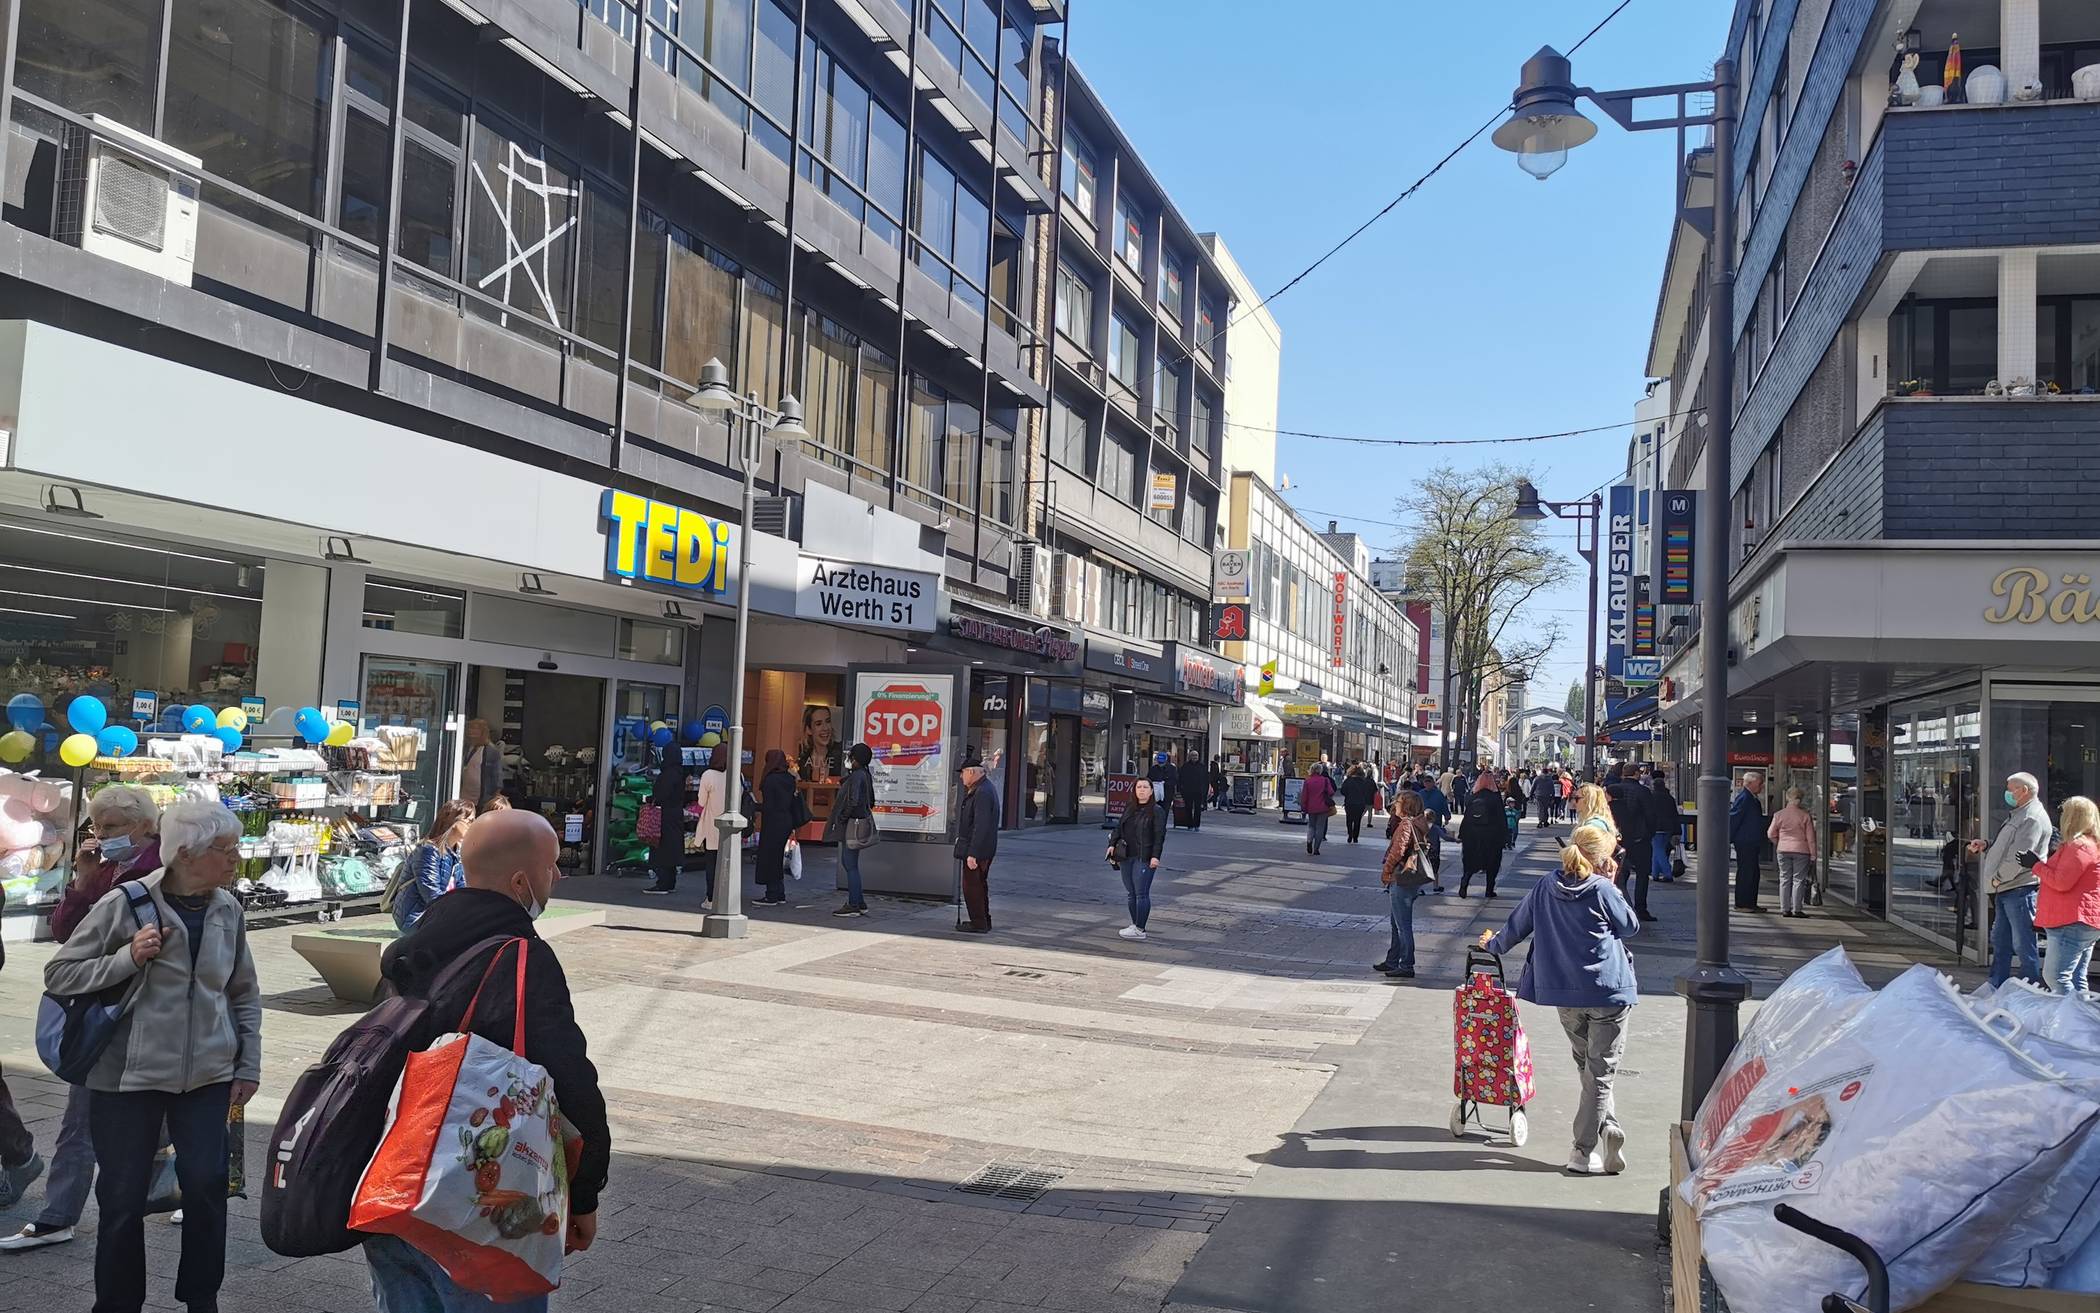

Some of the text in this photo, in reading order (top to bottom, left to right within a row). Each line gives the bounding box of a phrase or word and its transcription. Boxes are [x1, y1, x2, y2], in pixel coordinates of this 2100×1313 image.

[1672, 499, 1686, 511] M
[602, 488, 729, 595] TEDi
[811, 557, 921, 599] Ärztehaus
[1609, 514, 1631, 645] KLAUSER
[1984, 566, 2100, 624] Bä
[820, 591, 912, 625] Werth 51
[1333, 573, 1346, 667] WOOLWORTH
[1421, 696, 1435, 705] dm
[867, 711, 938, 737] STOP
[1231, 722, 1249, 730] DOG
[804, 756, 835, 769] ALIVE
[271, 1106, 316, 1189] FILA
